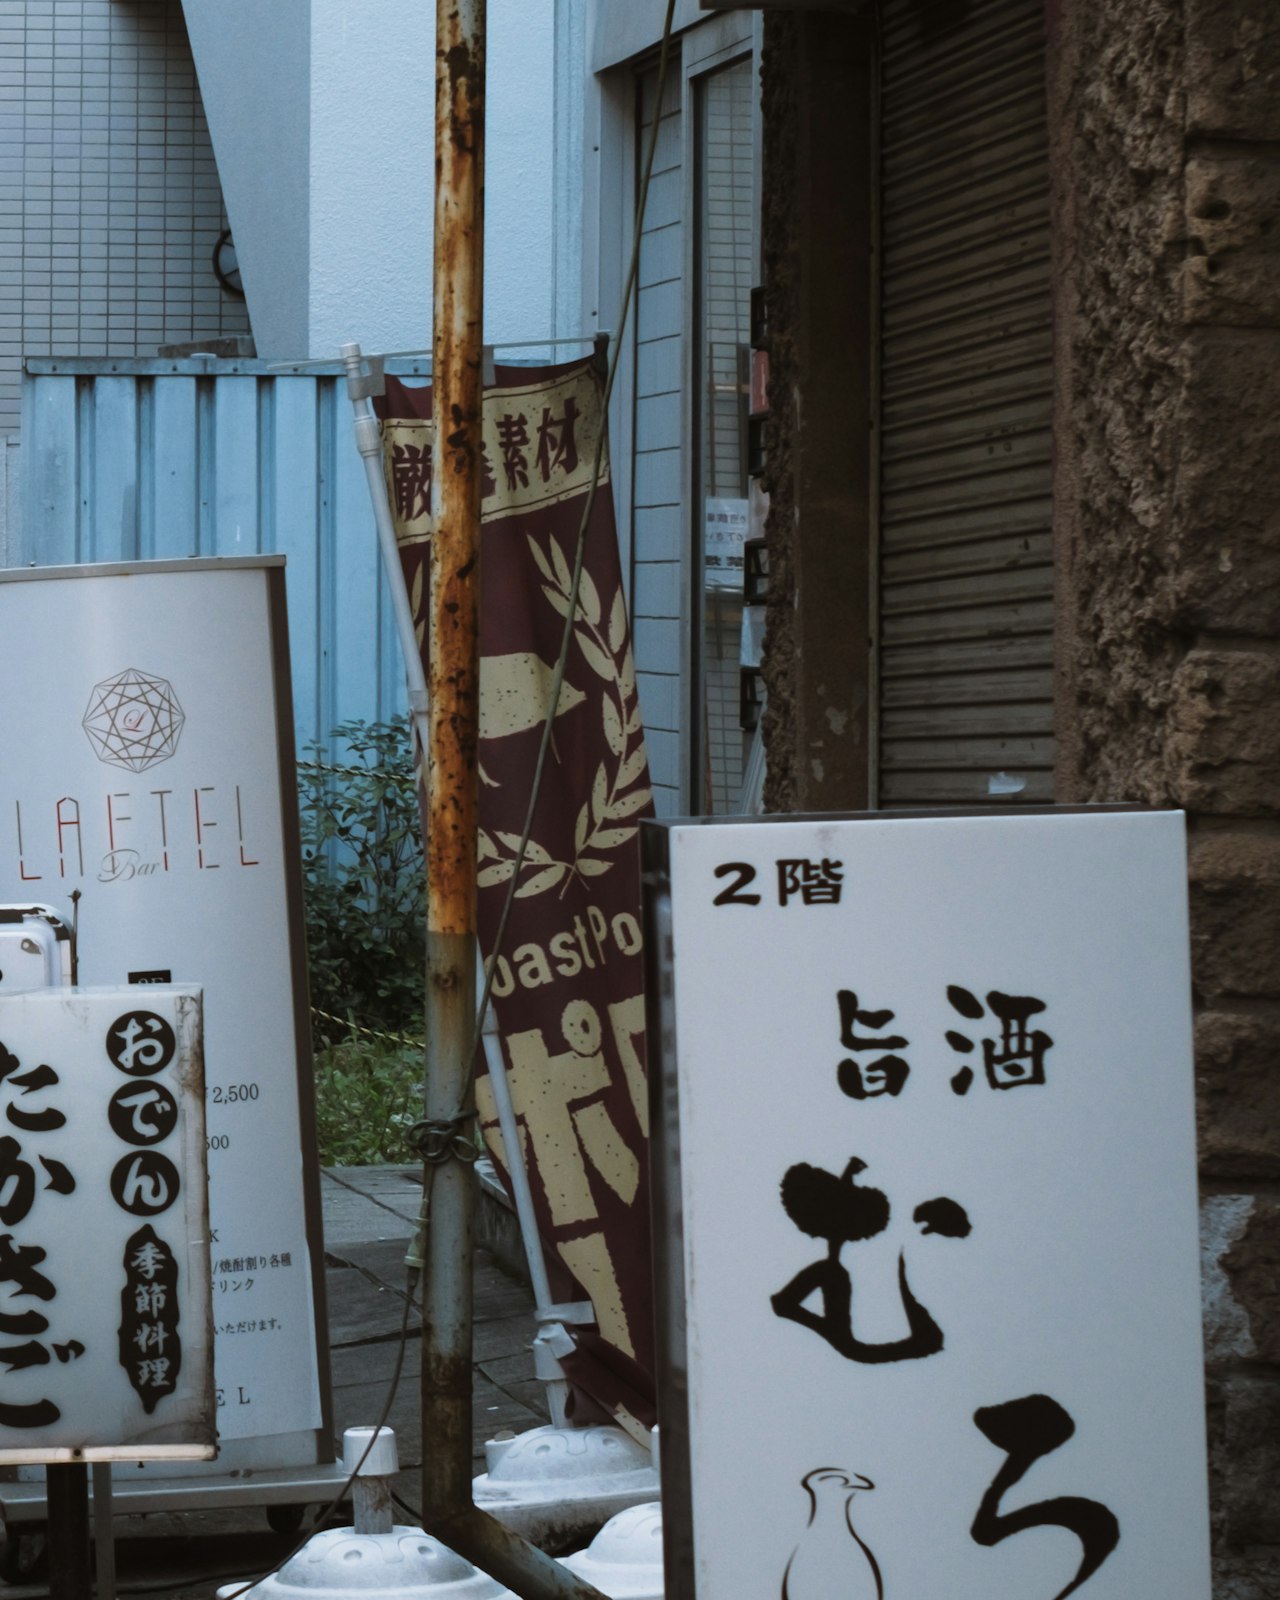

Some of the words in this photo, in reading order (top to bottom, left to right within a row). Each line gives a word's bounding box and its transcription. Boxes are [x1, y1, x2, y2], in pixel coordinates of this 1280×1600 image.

[392, 396, 582, 522] 厳素材
[16, 786, 260, 881] LAFTEL
[96, 848, 161, 883] Bar
[712, 856, 845, 909] 2階
[206, 1083, 260, 1105] 2,500
[835, 984, 1054, 1100] 旨酒
[114, 1016, 171, 1208] おでん
[130, 1241, 171, 1387] 季節料理
